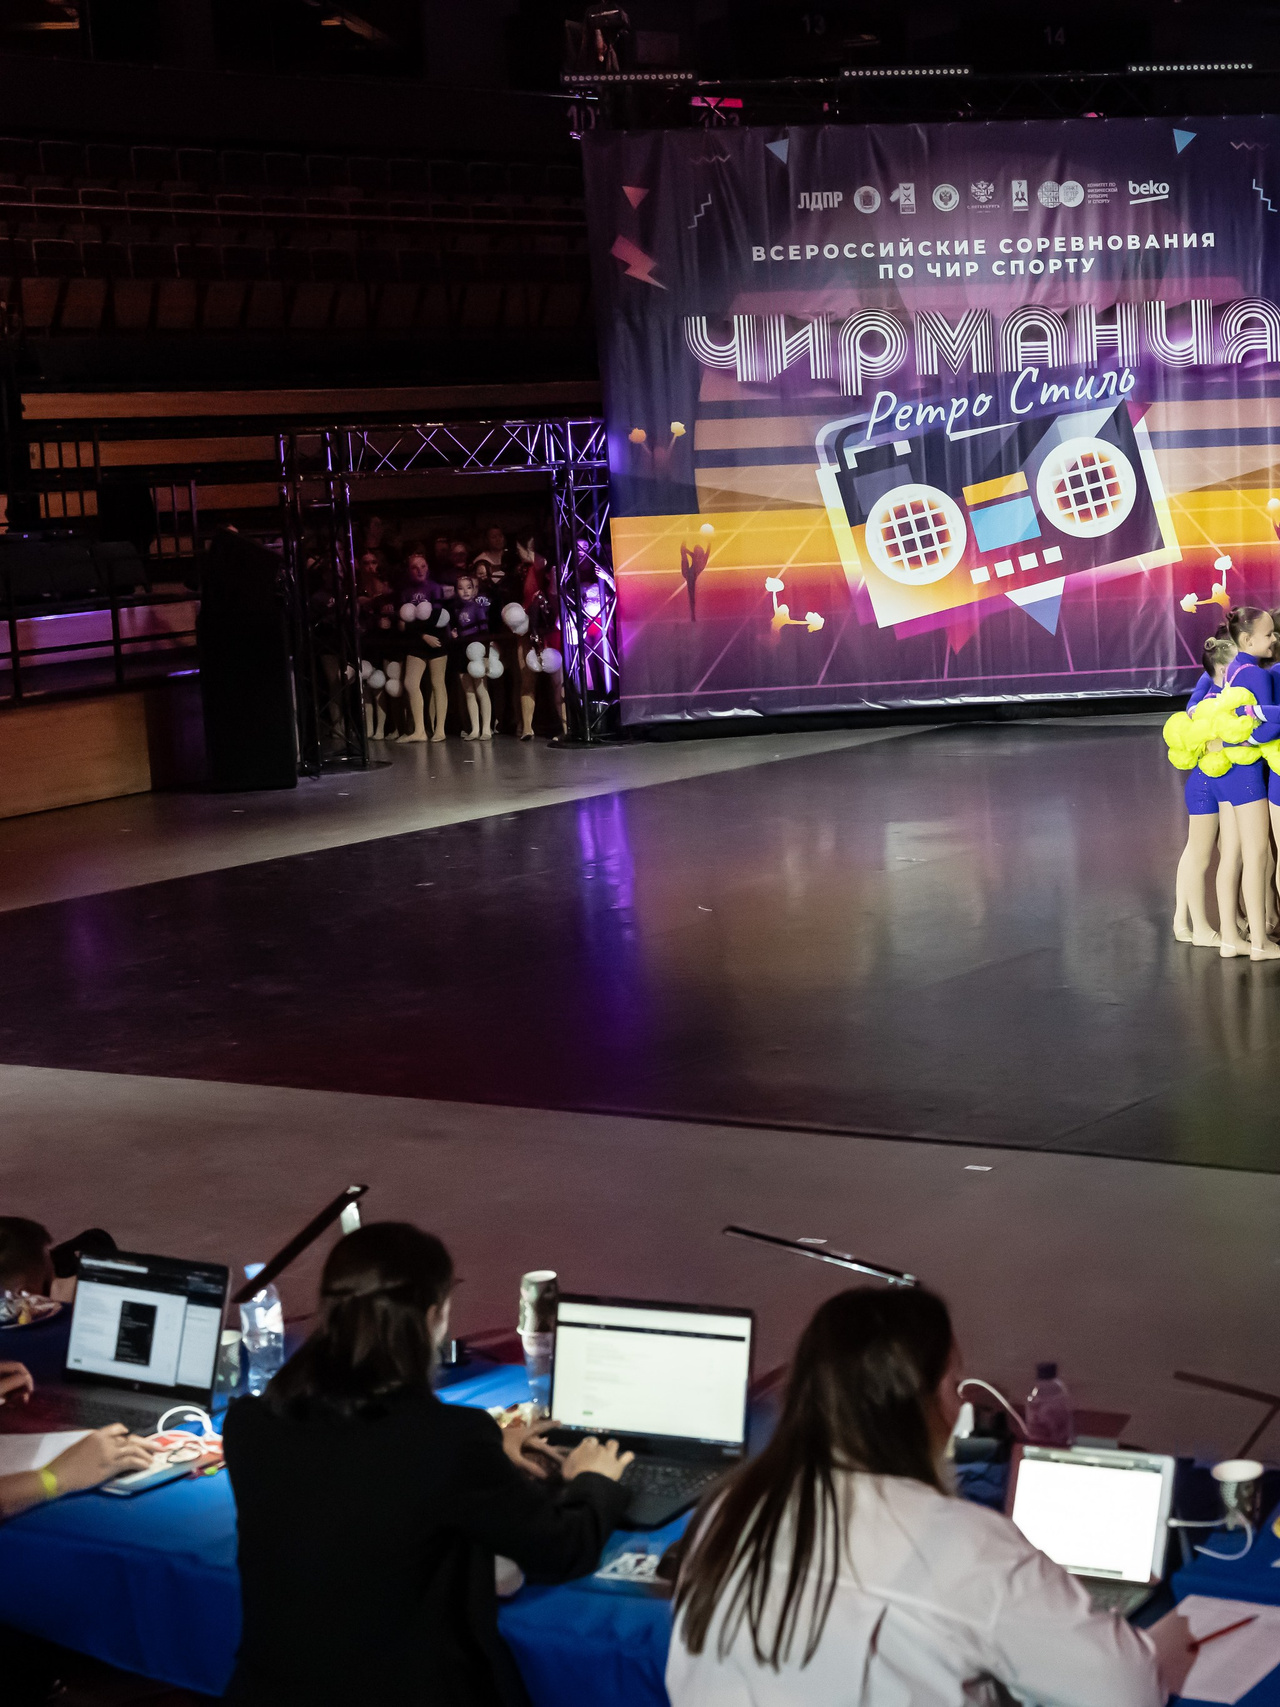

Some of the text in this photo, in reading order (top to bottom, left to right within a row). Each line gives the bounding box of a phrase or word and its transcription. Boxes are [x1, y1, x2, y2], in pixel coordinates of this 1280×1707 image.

[1128, 180, 1170, 196] beko
[797, 191, 843, 212] ЛДПР
[752, 232, 1216, 262] ВСЕРОССИЙСКИЕ СОРЕВНОВАНИЯ
[878, 257, 1095, 279] ПО ЧИР СПОРТУ
[866, 366, 1136, 441] Ретро Стиль
